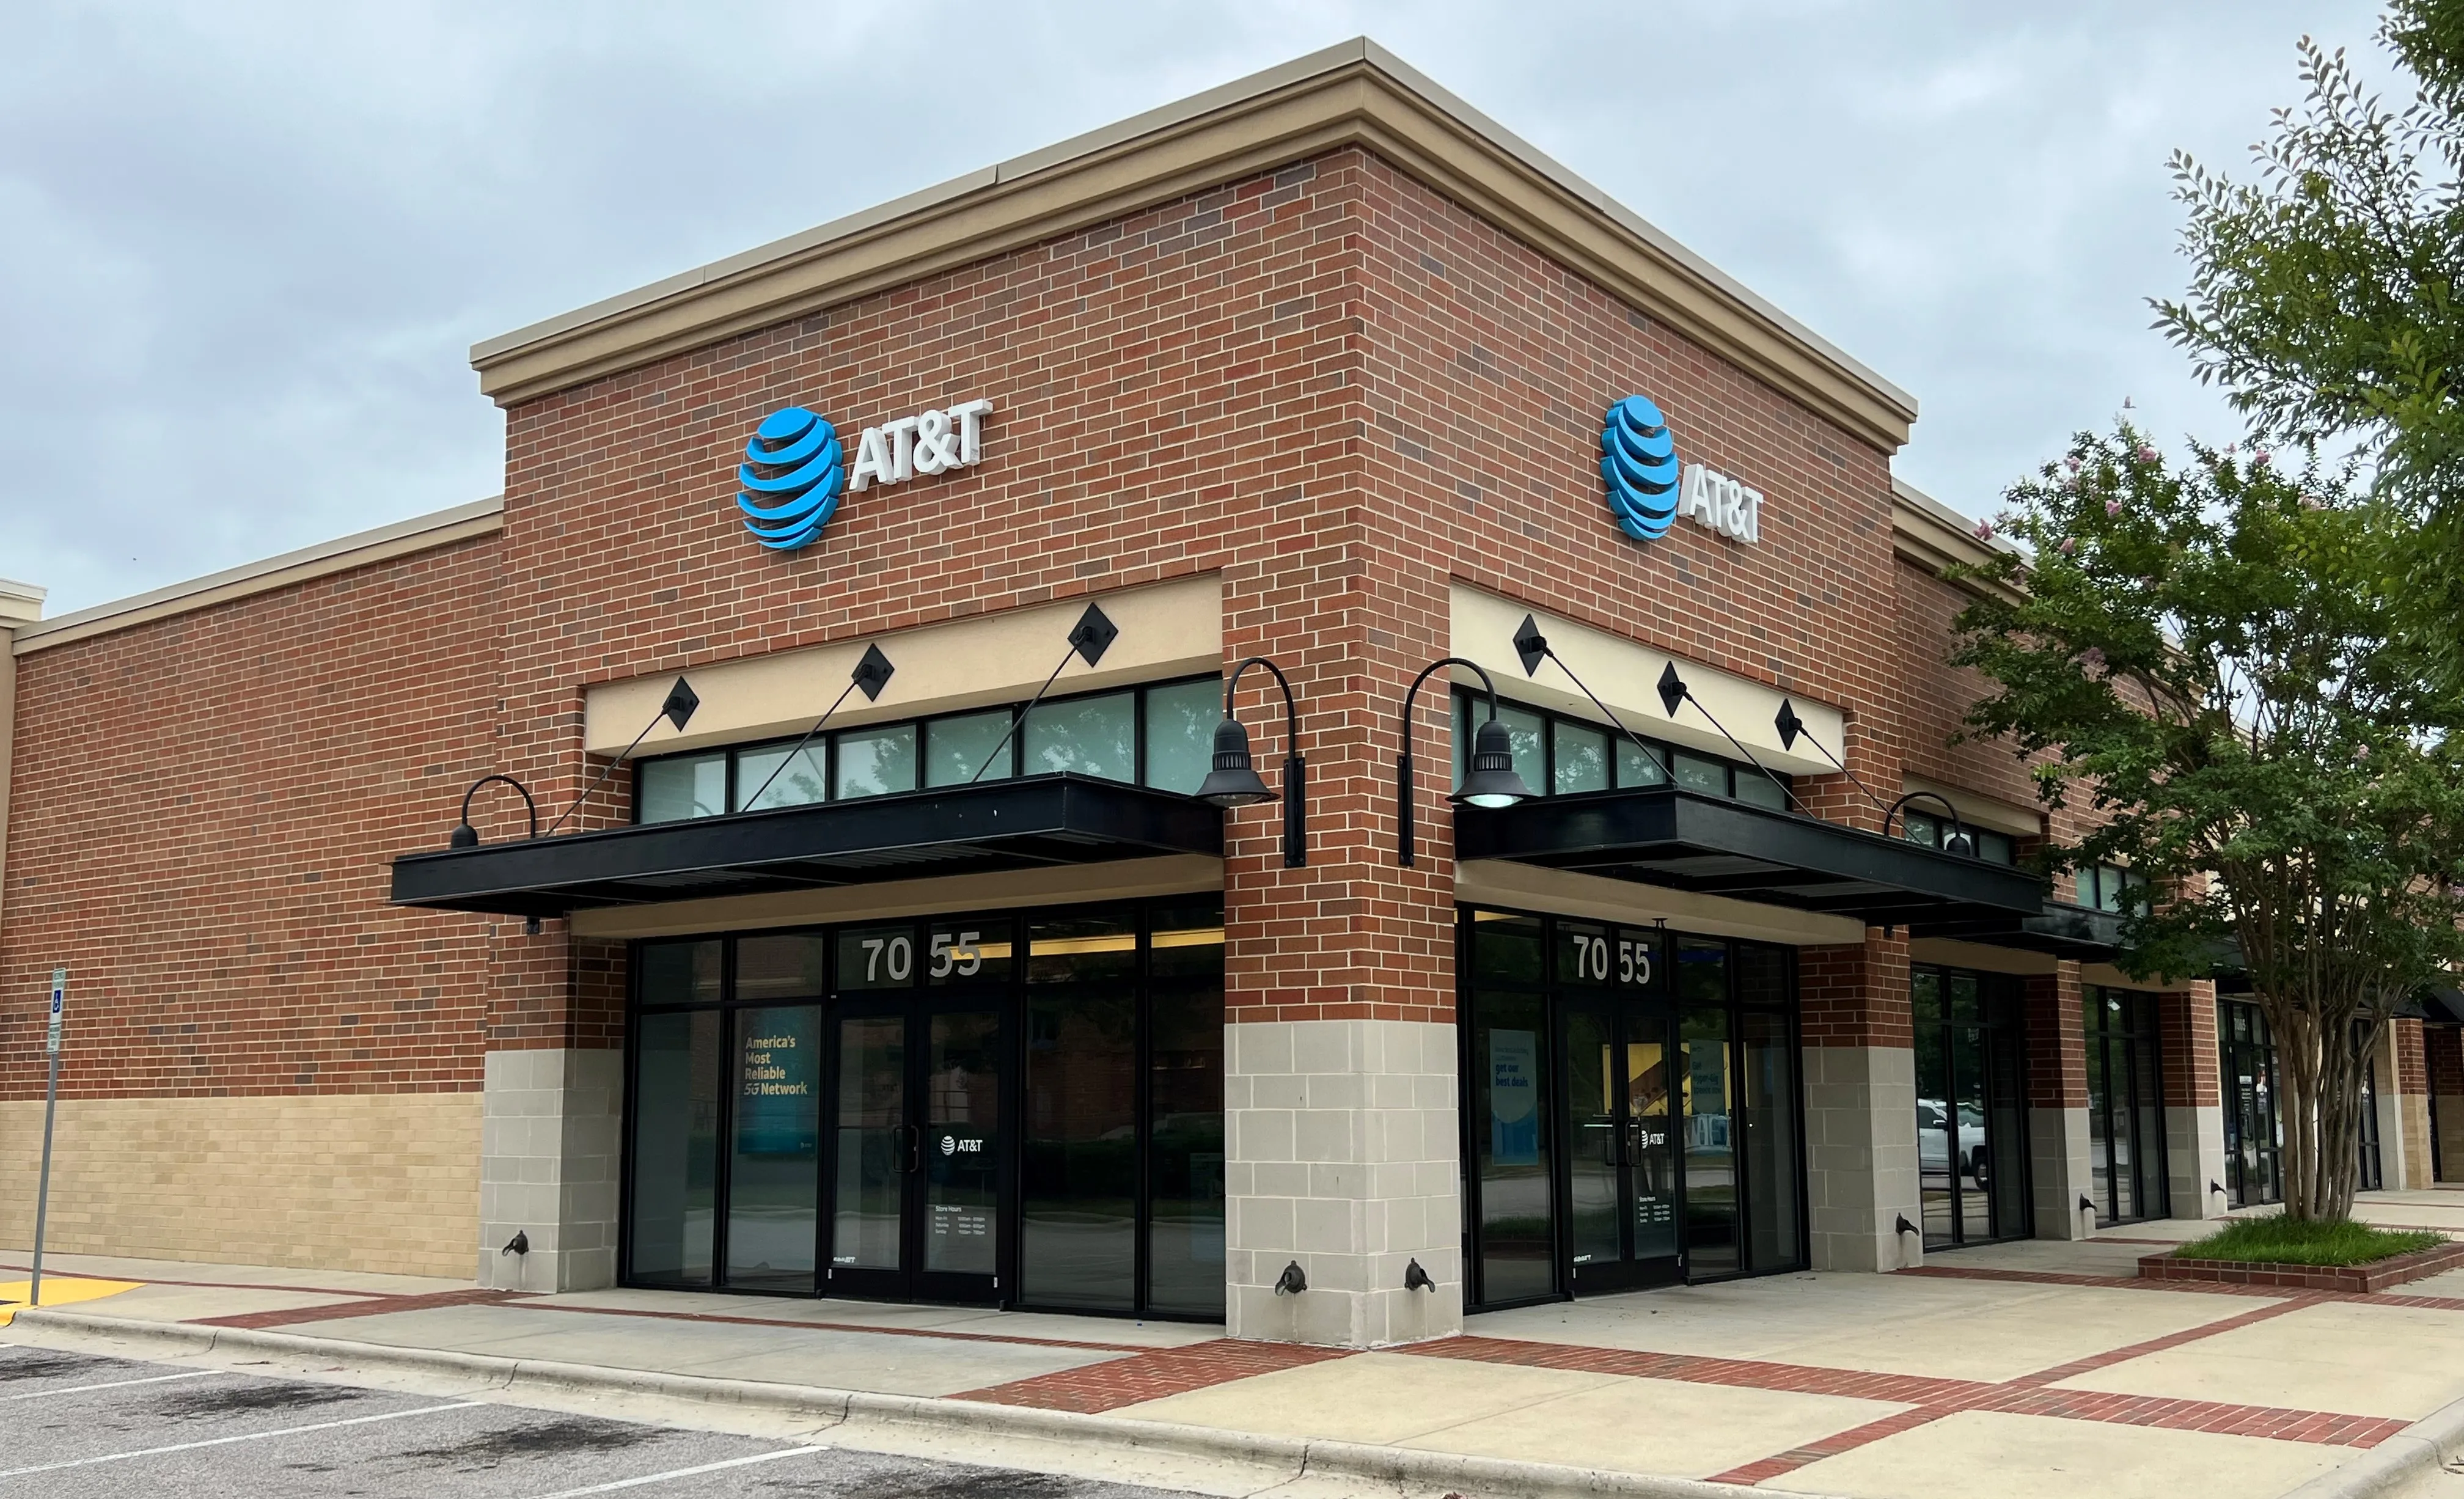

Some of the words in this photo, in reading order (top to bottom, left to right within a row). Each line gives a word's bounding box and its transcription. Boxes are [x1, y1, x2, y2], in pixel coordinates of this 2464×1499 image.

[849, 398, 993, 492] AT&T
[1678, 463, 1764, 544] AT&T
[746, 1035, 796, 1049] America's
[746, 1052, 771, 1064] Most
[745, 1066, 786, 1080] Reliable
[1495, 1064, 1507, 1075] get
[744, 1083, 760, 1095] 5G
[761, 1081, 807, 1095] Network
[1495, 1076, 1510, 1087] best
[1511, 1076, 1528, 1087] deals
[957, 1140, 983, 1151] AT&T
[1649, 1133, 1665, 1145] AT&T
